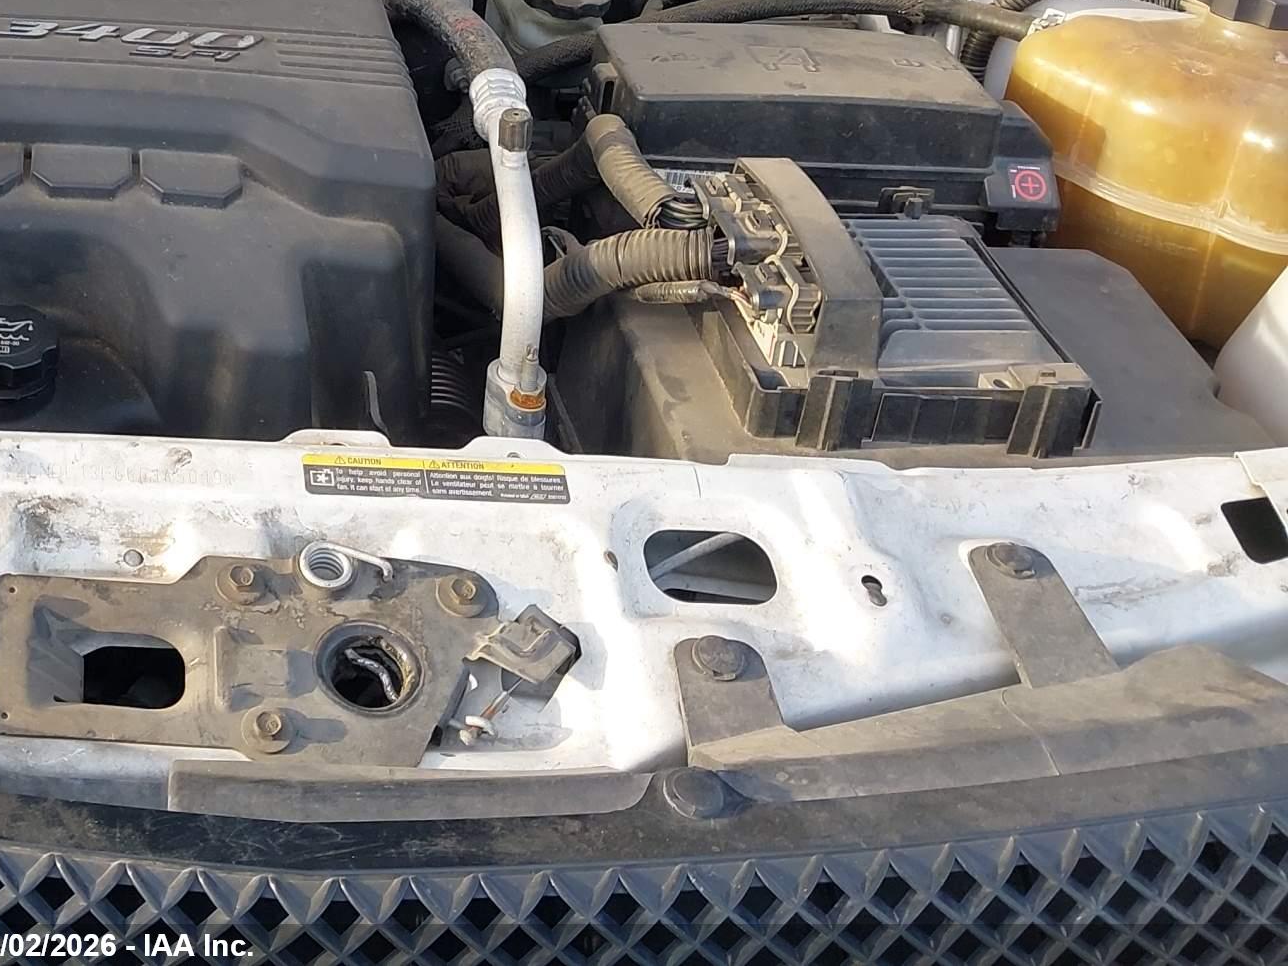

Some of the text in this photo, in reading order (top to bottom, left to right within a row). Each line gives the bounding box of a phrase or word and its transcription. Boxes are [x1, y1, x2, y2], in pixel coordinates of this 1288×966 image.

[347, 457, 382, 465] CAUTION
[441, 461, 484, 469] ATTENTION
[349, 468, 363, 476] help
[369, 469, 387, 477] avoid
[393, 470, 420, 478] personal
[430, 472, 458, 480] Attention
[376, 477, 395, 485] hands
[397, 478, 412, 486] clear
[356, 484, 368, 492] can
